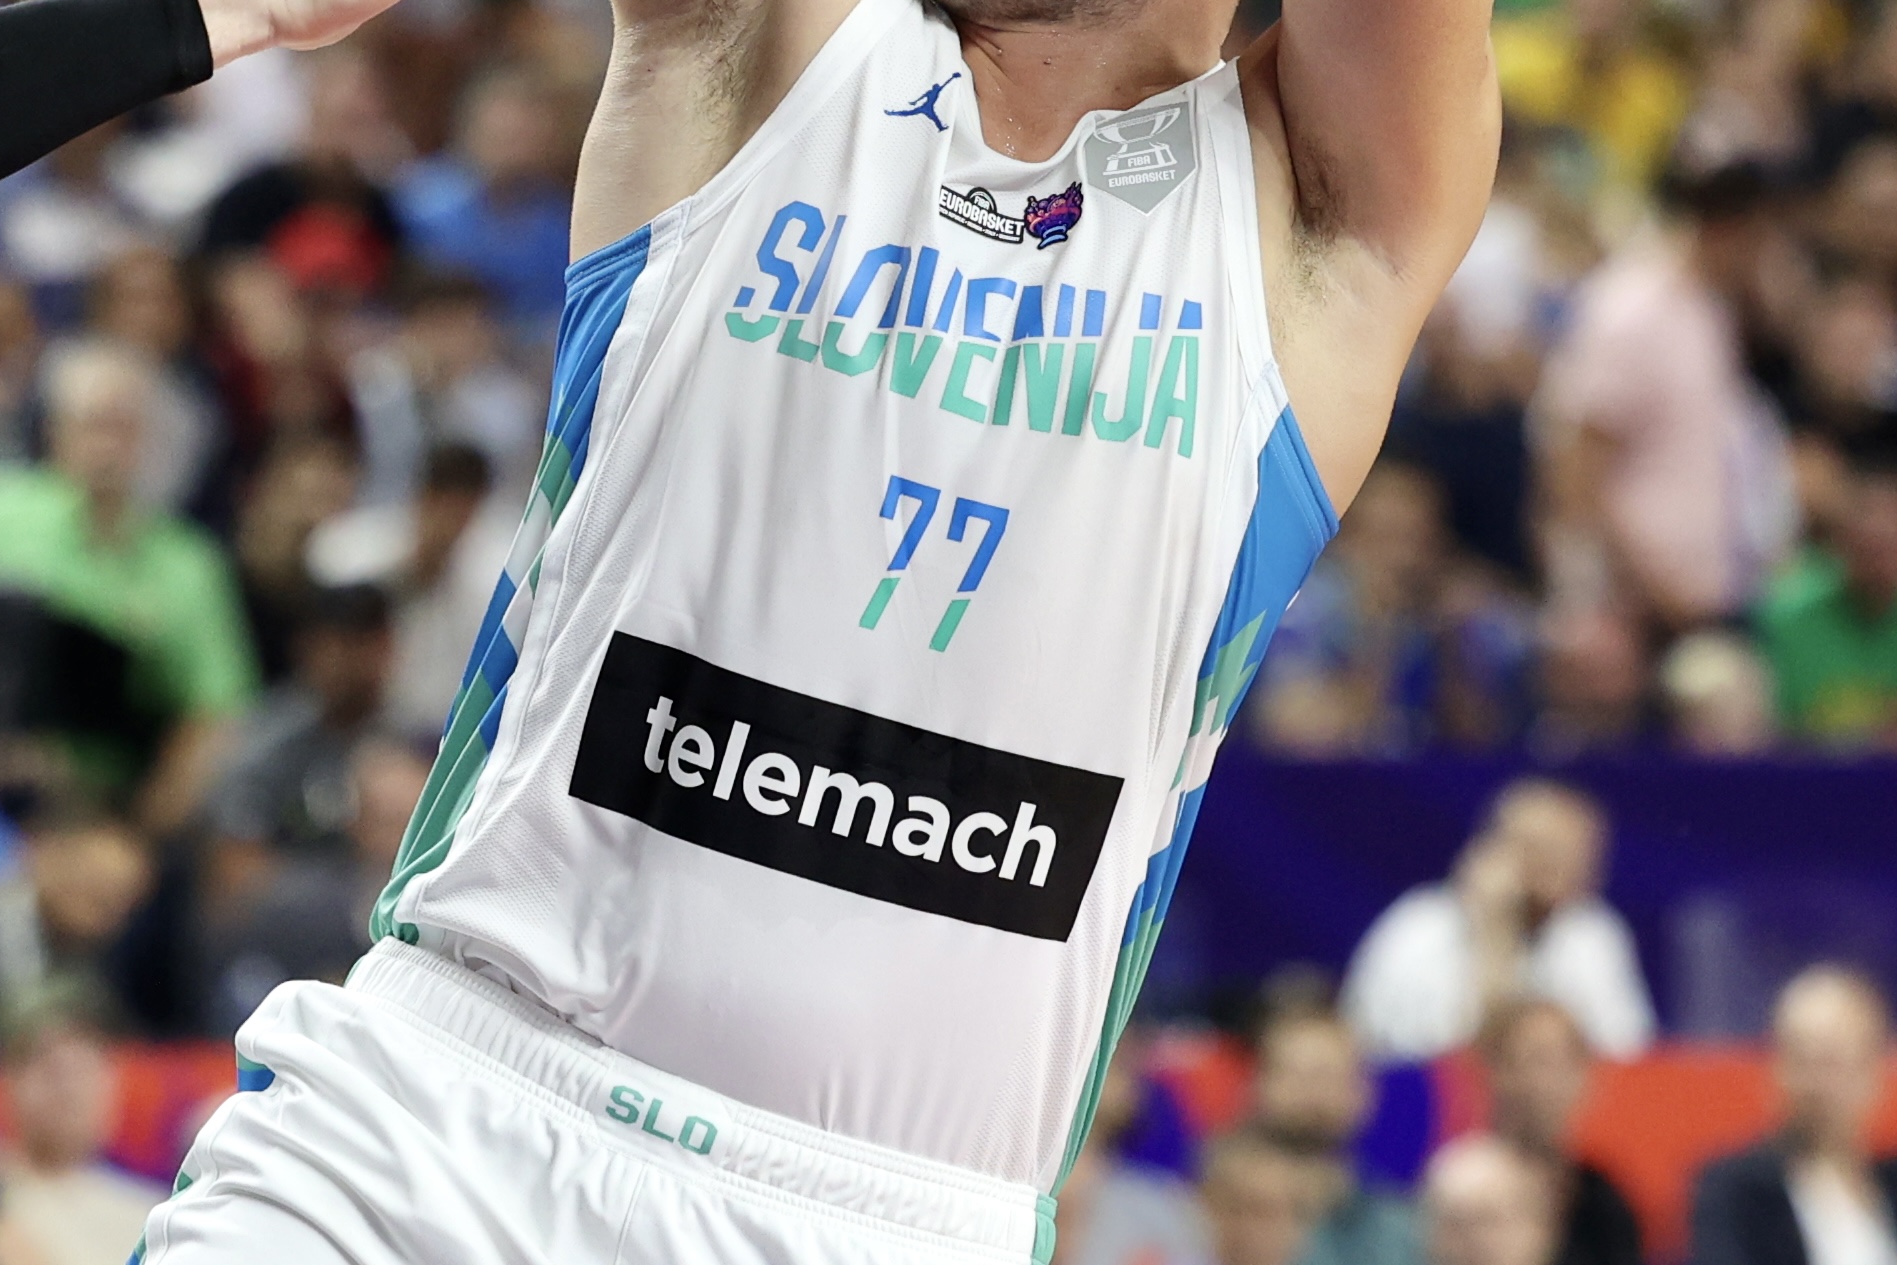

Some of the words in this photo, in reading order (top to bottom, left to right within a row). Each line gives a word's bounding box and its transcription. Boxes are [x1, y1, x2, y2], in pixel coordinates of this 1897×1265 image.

[1108, 169, 1177, 189] EUROBASKET
[1127, 155, 1152, 168] FIBA
[938, 188, 1024, 236] EUROBASKET
[725, 200, 1203, 458] SLOVENIJA
[858, 474, 1010, 653] 77
[643, 695, 1056, 888] telemach
[605, 1085, 718, 1156] SLO
